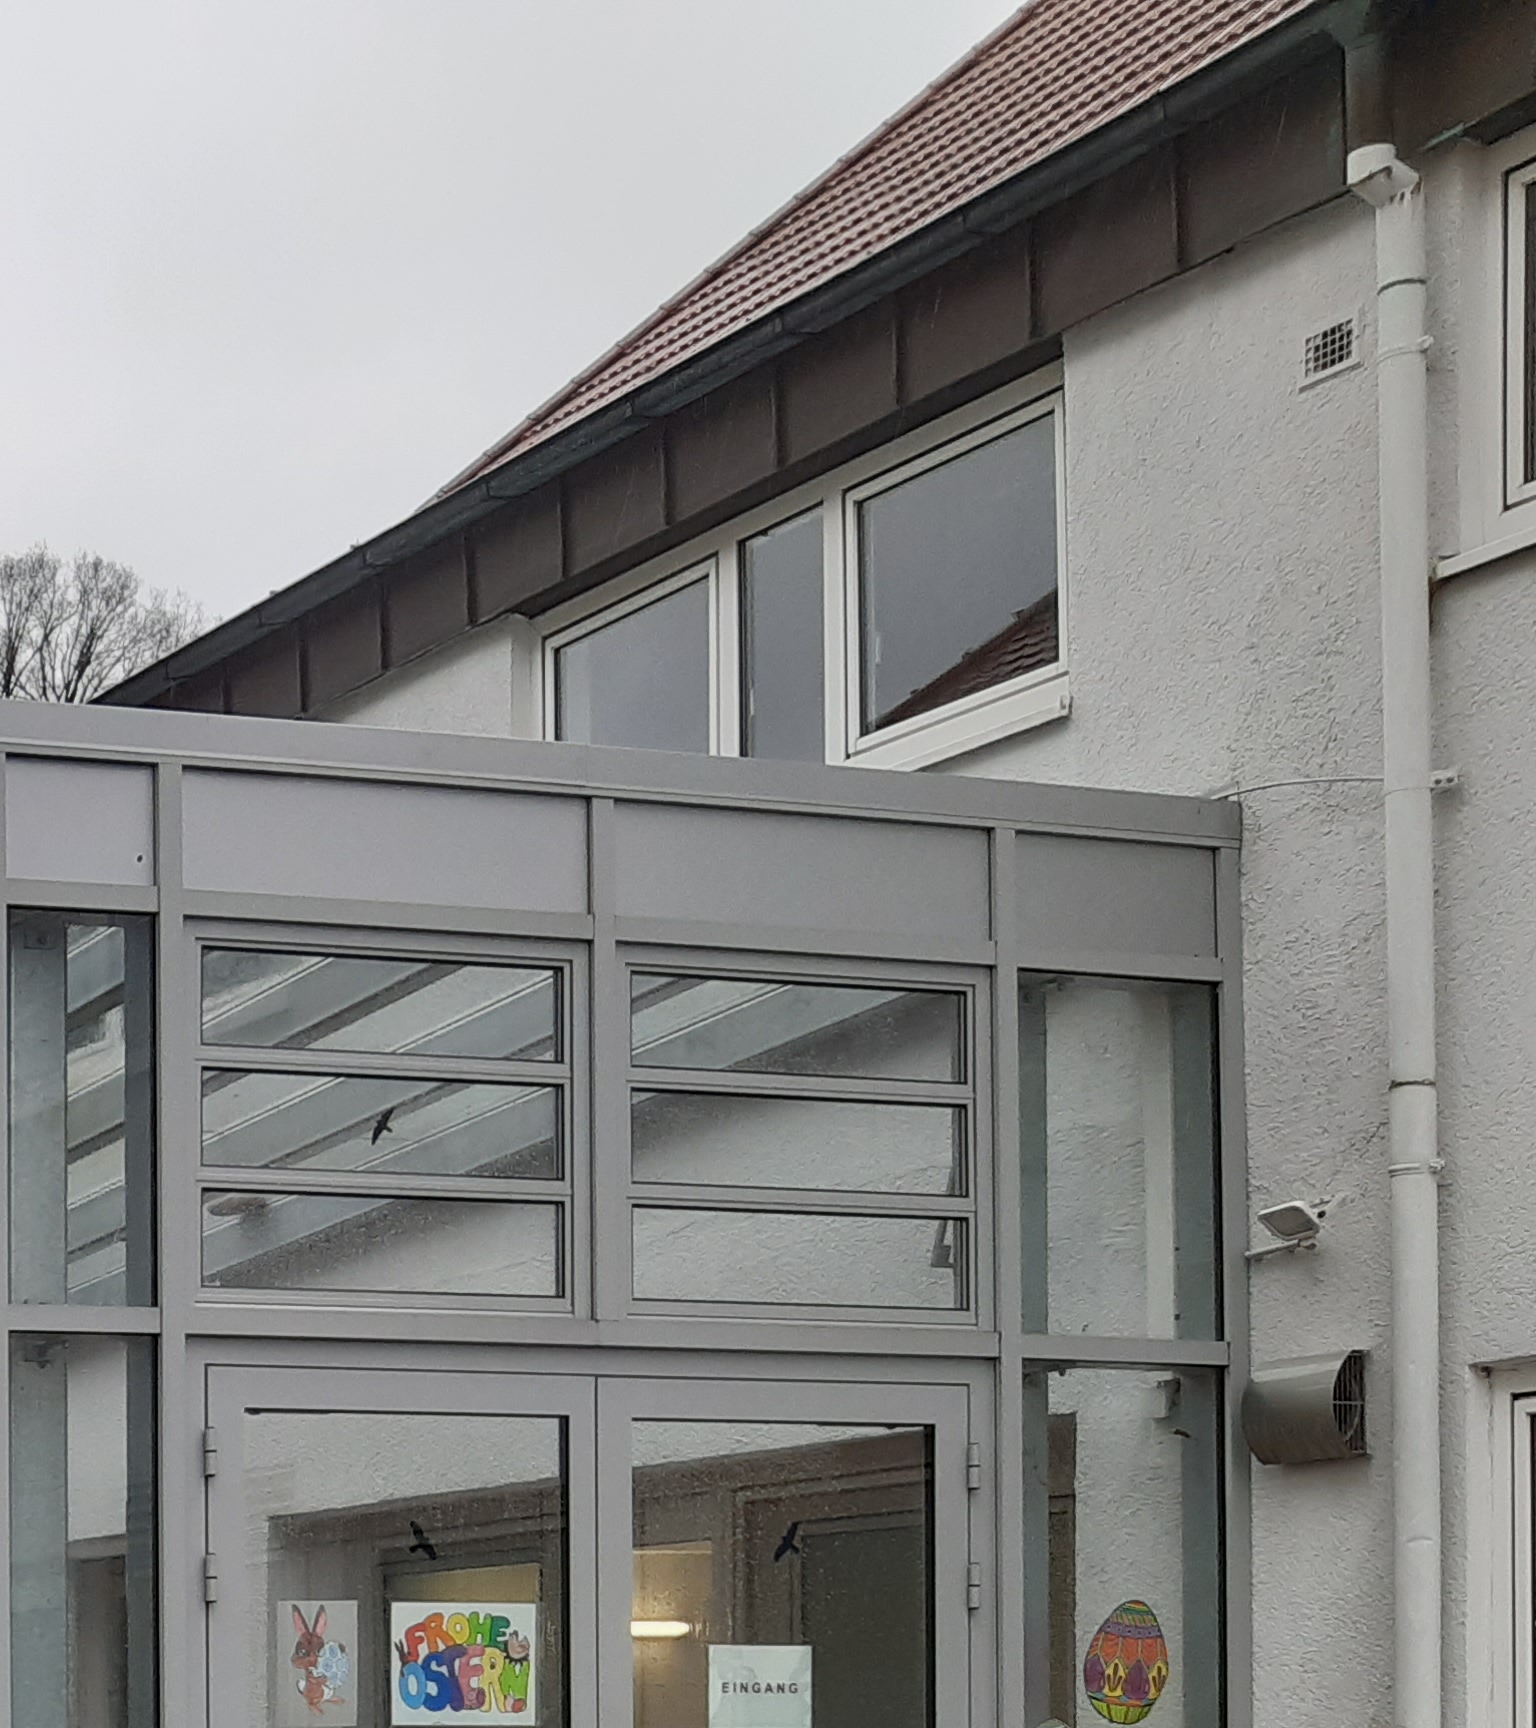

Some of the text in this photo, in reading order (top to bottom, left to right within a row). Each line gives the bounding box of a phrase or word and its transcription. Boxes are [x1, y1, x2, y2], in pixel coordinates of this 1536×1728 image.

[405, 1611, 511, 1663] FROHE
[399, 1644, 530, 1713] OSTERN
[721, 1682, 798, 1693] EINGANG
